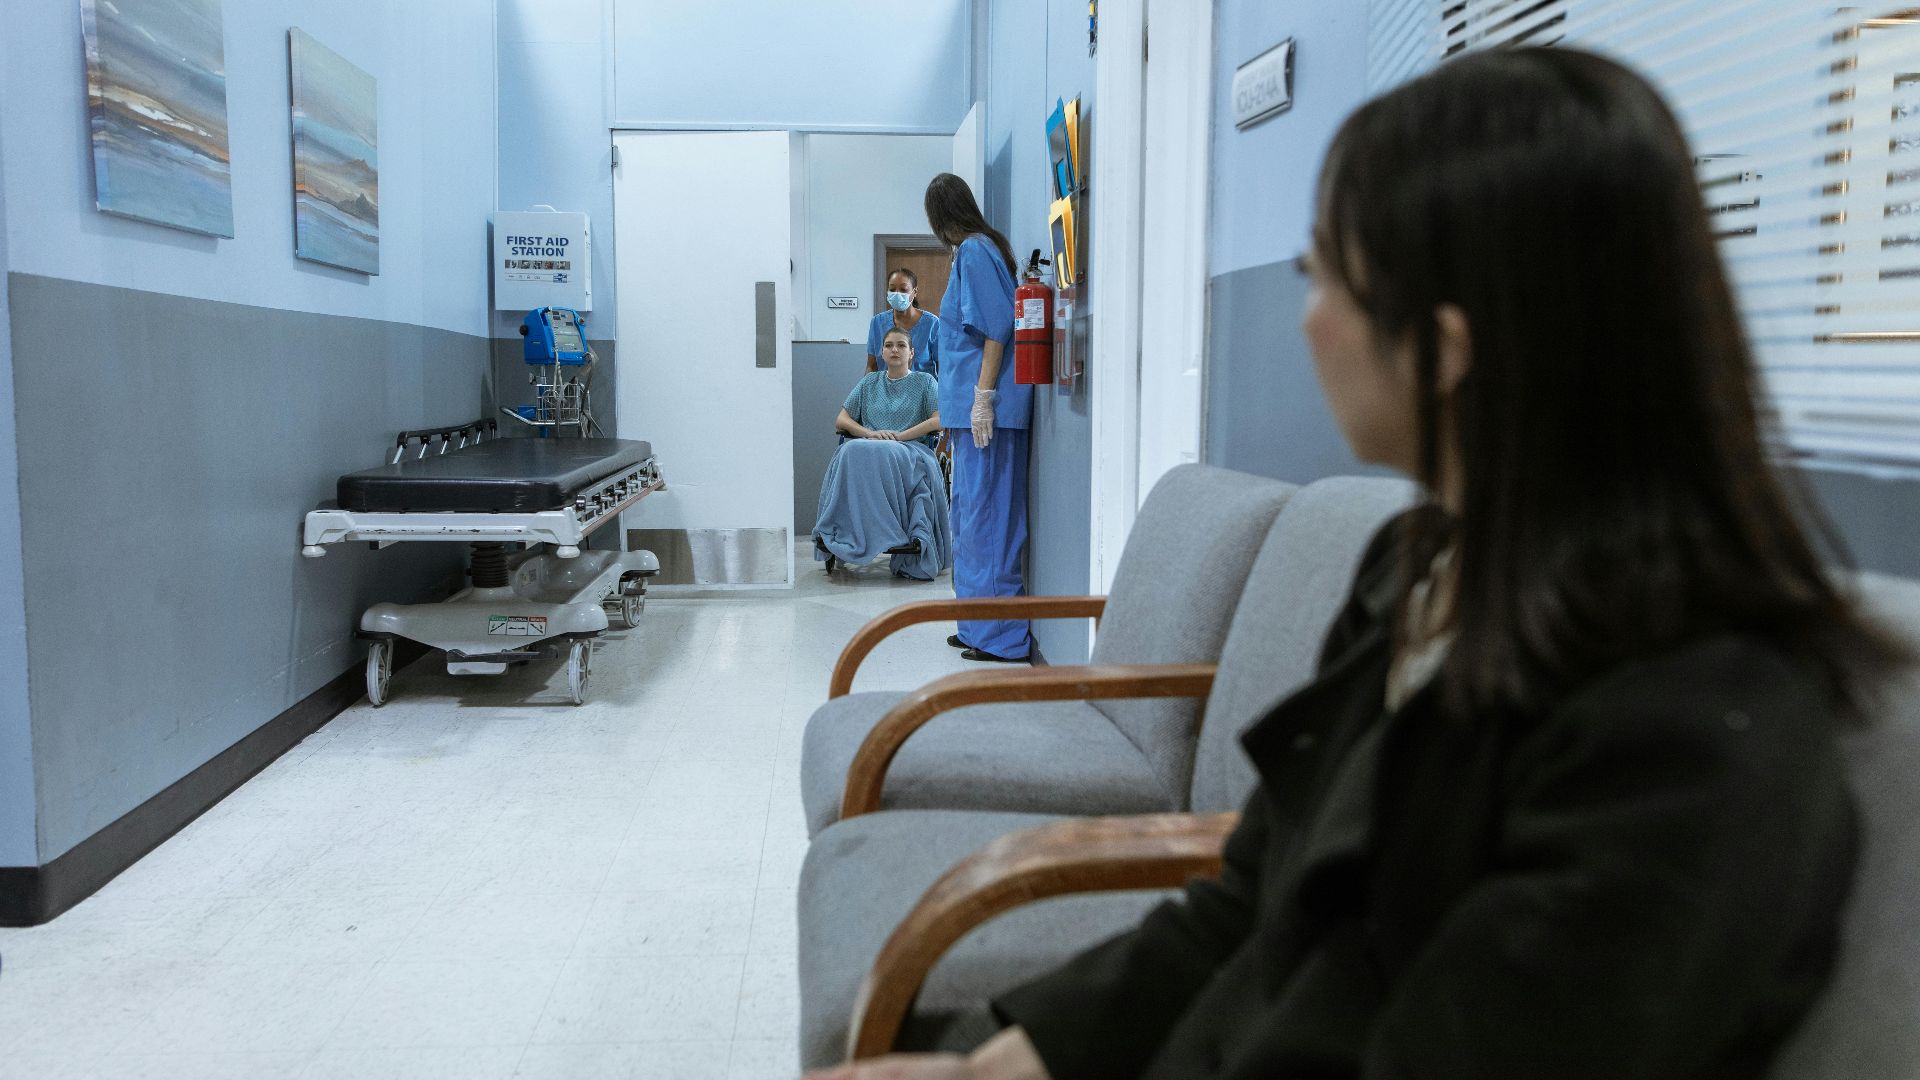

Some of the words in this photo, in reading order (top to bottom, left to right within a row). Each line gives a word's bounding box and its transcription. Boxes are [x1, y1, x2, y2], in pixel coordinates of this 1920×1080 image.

[506, 236, 543, 246] FIRST
[545, 237, 569, 246] AID
[511, 246, 565, 256] STATION
